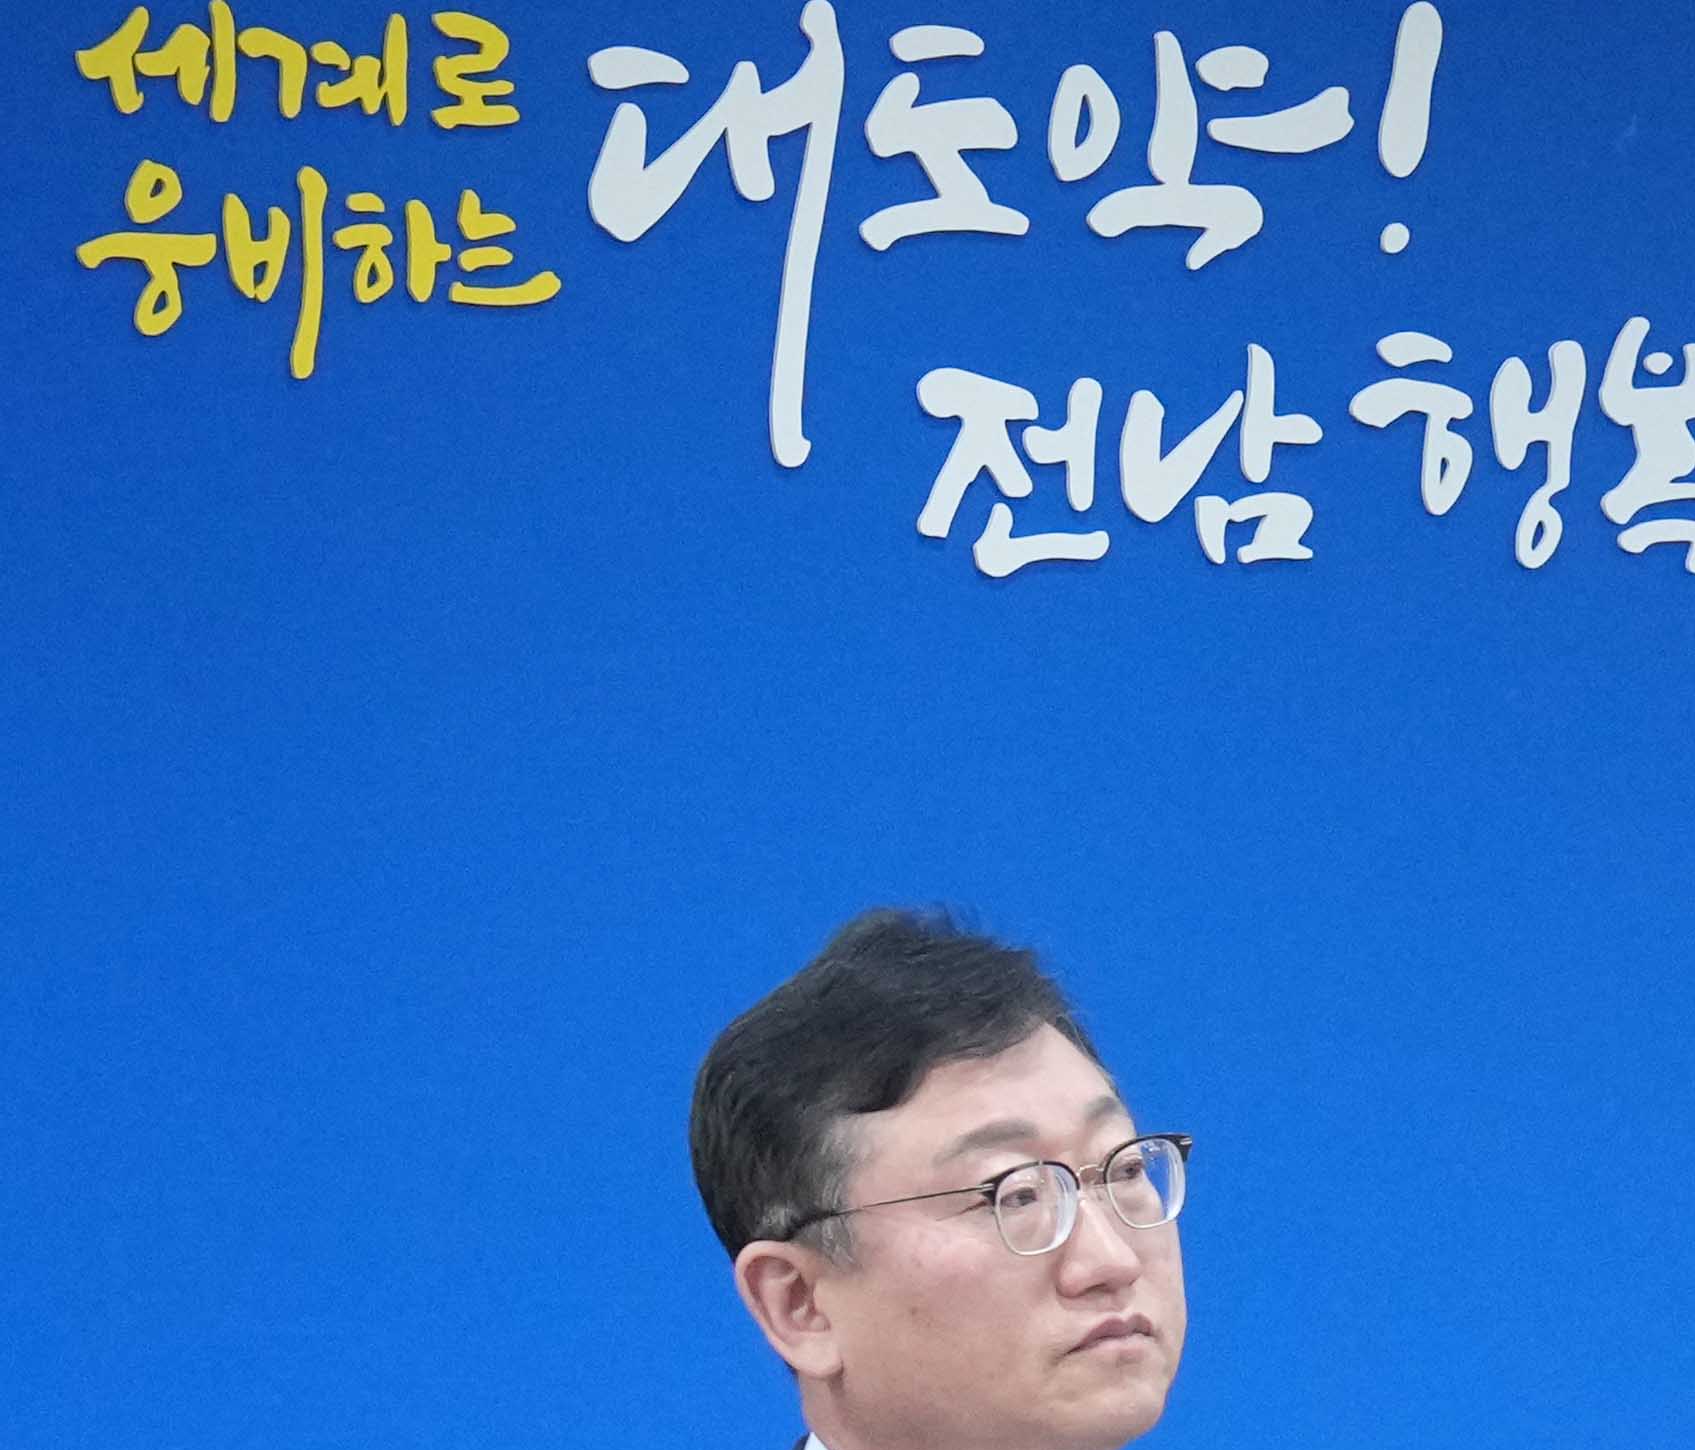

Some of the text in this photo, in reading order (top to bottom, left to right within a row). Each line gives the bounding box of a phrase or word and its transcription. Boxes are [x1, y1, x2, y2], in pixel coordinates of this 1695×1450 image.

[77, 5, 519, 128] 세계로
[78, 161, 560, 378] 웅비하는
[588, 0, 1442, 467] 대도약!
[917, 344, 1323, 577] 전남
